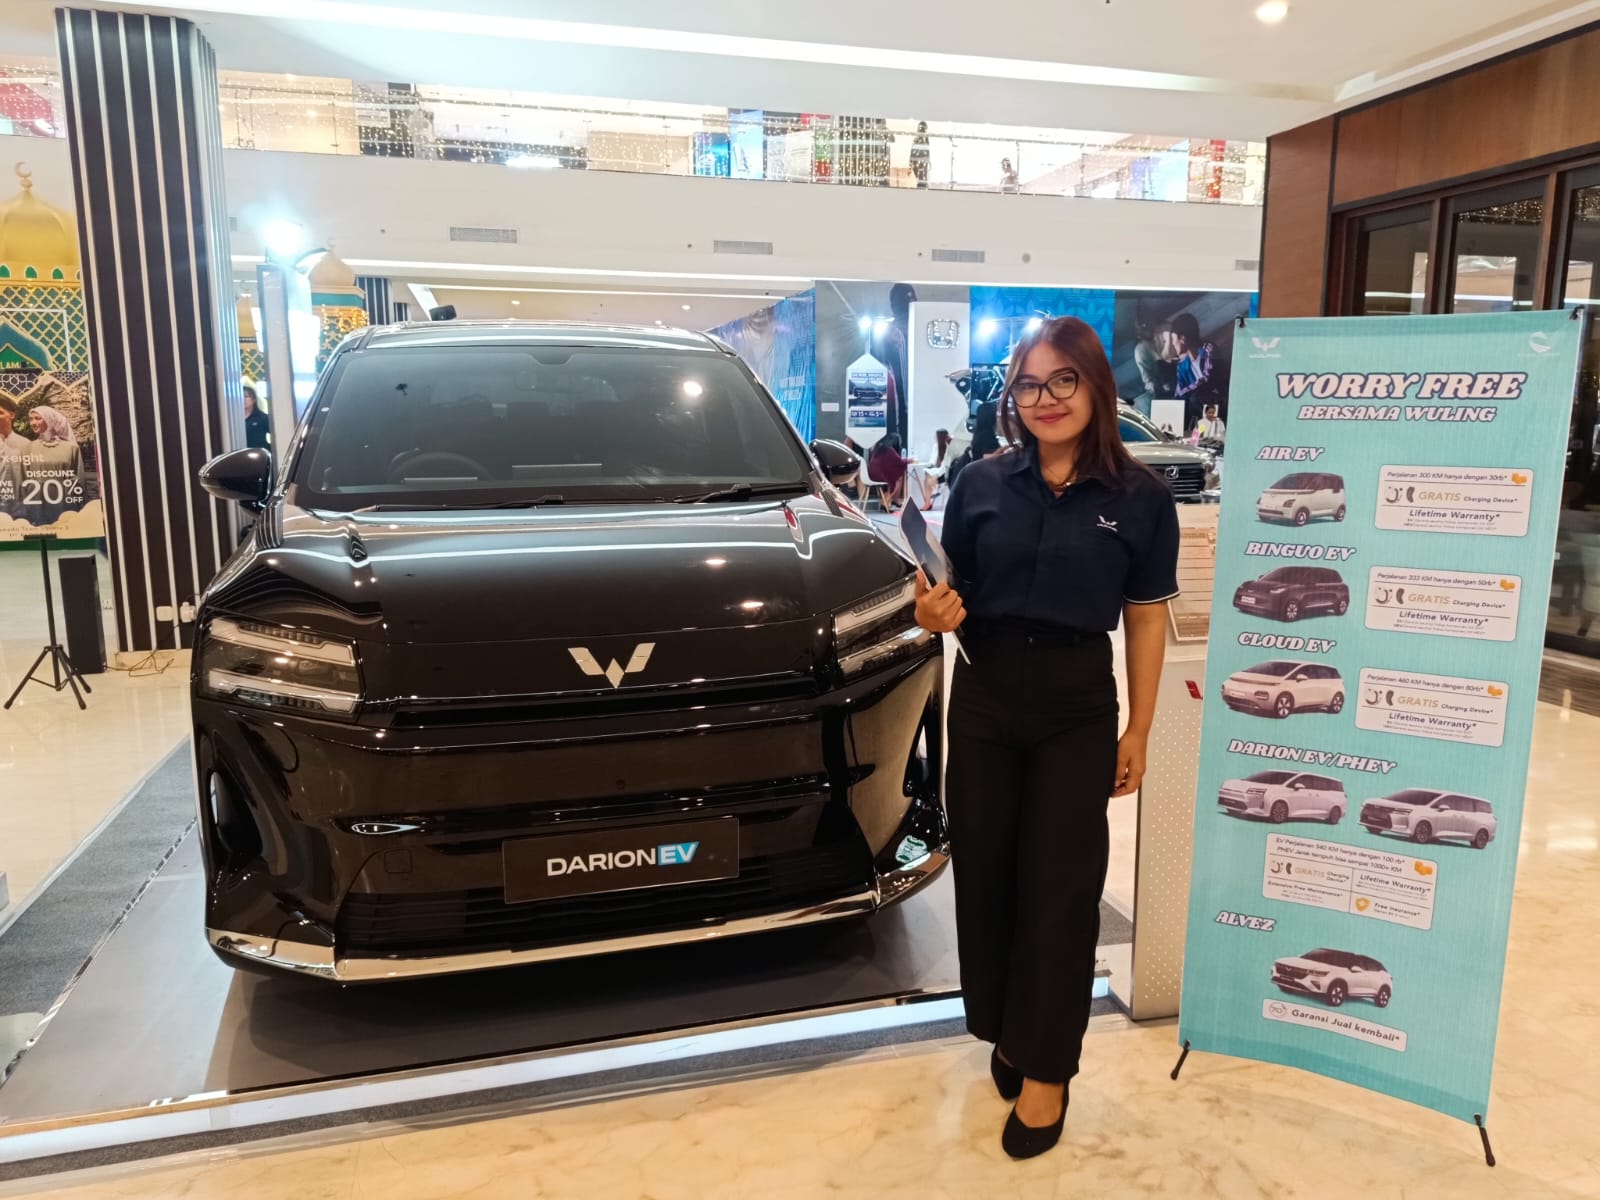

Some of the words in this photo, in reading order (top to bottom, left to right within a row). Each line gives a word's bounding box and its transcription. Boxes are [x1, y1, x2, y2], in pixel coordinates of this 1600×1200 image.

[1276, 372, 1421, 400] WORRY
[1416, 372, 1528, 400] FREE
[1296, 405, 1402, 420] BERSAMA
[1404, 406, 1497, 422] WULING
[1255, 446, 1293, 460] AIR
[1293, 446, 1325, 462] EV
[1464, 473, 1488, 482] dengan
[22, 479, 83, 504] 20%
[1418, 491, 1461, 501] GRATIS
[1410, 509, 1447, 518] Lifetime
[1244, 541, 1324, 559] BINGUO
[1324, 546, 1356, 562] EV
[1452, 577, 1476, 586] dengan
[1408, 593, 1450, 605] GRATIS
[1399, 610, 1436, 620] Lifetime
[1238, 632, 1305, 651] CLOUD
[1304, 638, 1337, 654] EV
[1441, 682, 1465, 691] dengan
[1398, 696, 1439, 708] GRATIS
[1441, 704, 1468, 712] Charging
[1389, 712, 1425, 723] Lifetime
[1228, 739, 1302, 762] DARION
[1302, 751, 1397, 774] EV/PHEV
[547, 848, 656, 876] DARION
[1295, 866, 1325, 878] GRATIS
[1360, 874, 1390, 885] Lifetime
[1215, 910, 1276, 932] ALVEZ
[1292, 1009, 1329, 1023] Garansi
[1331, 1017, 1352, 1030] Jual
